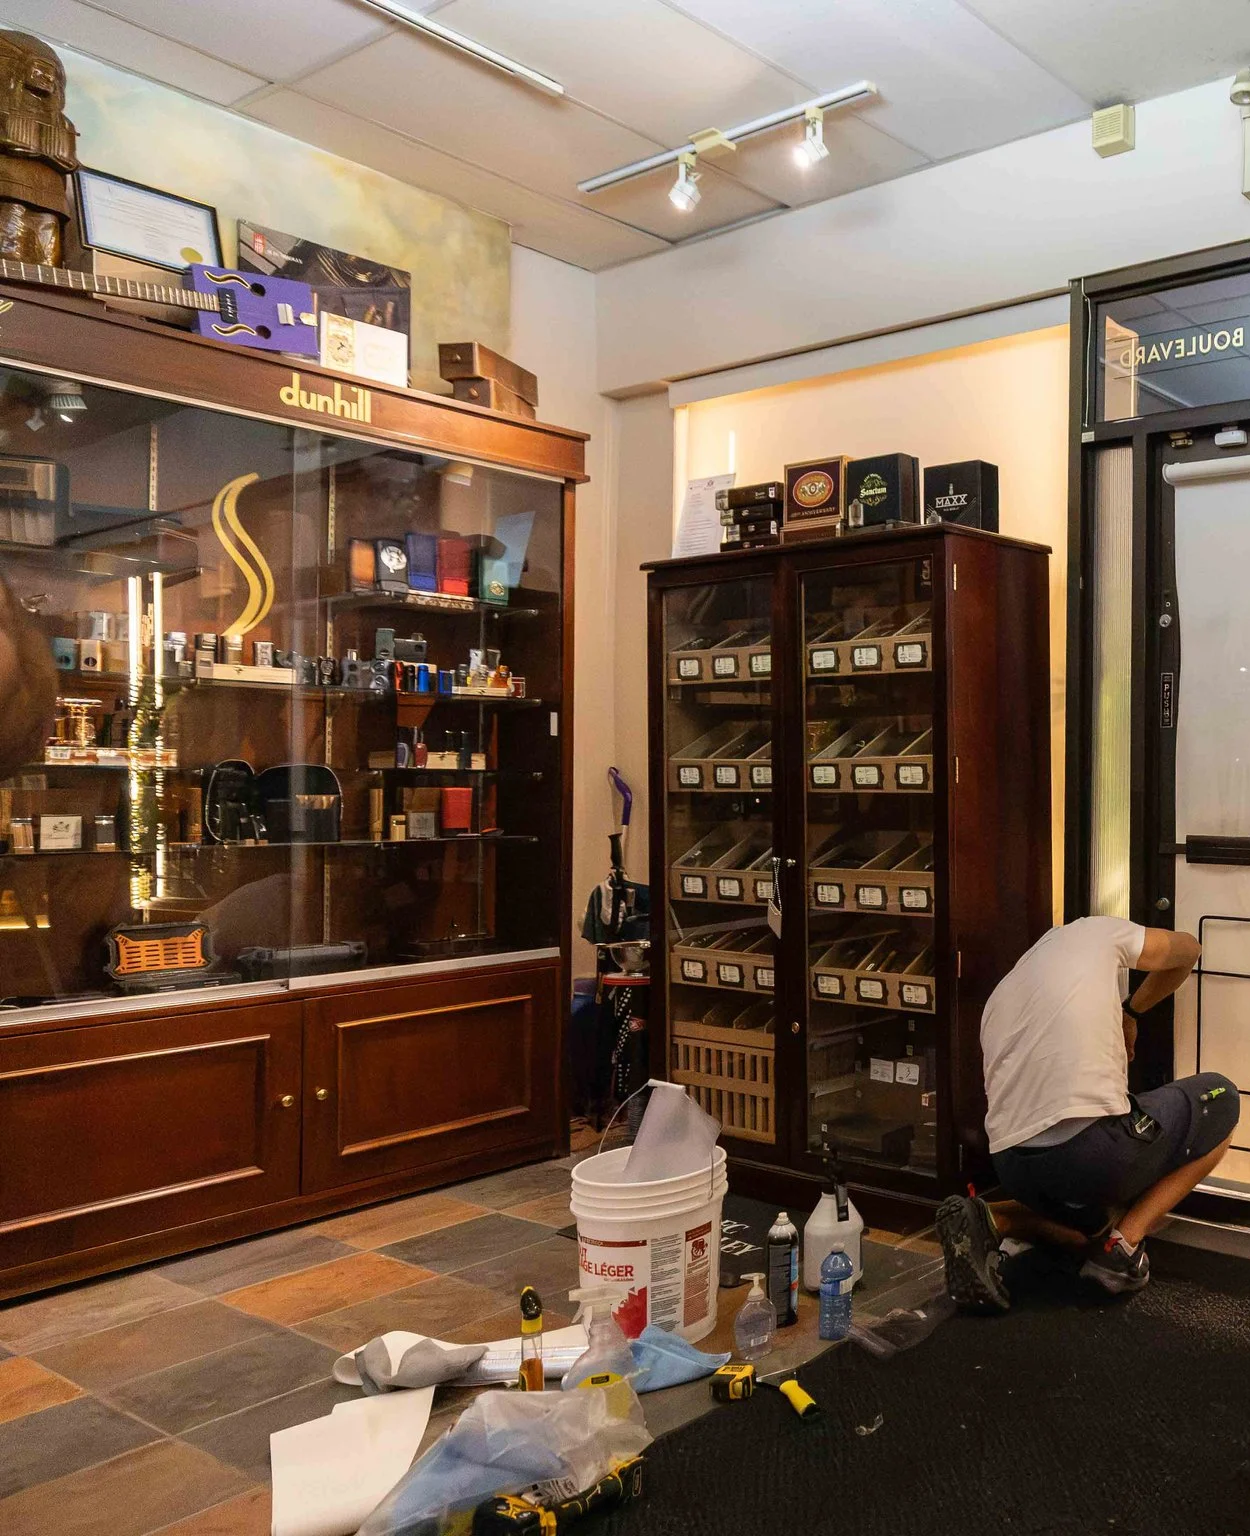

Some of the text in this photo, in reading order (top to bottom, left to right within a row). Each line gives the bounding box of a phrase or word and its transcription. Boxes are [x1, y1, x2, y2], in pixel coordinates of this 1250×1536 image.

[279, 372, 371, 423] dunhill
[860, 487, 887, 498] Sanctum
[935, 494, 968, 508] MAXX
[1163, 683, 1171, 718] PUSH
[594, 1262, 634, 1277] LÉGER
